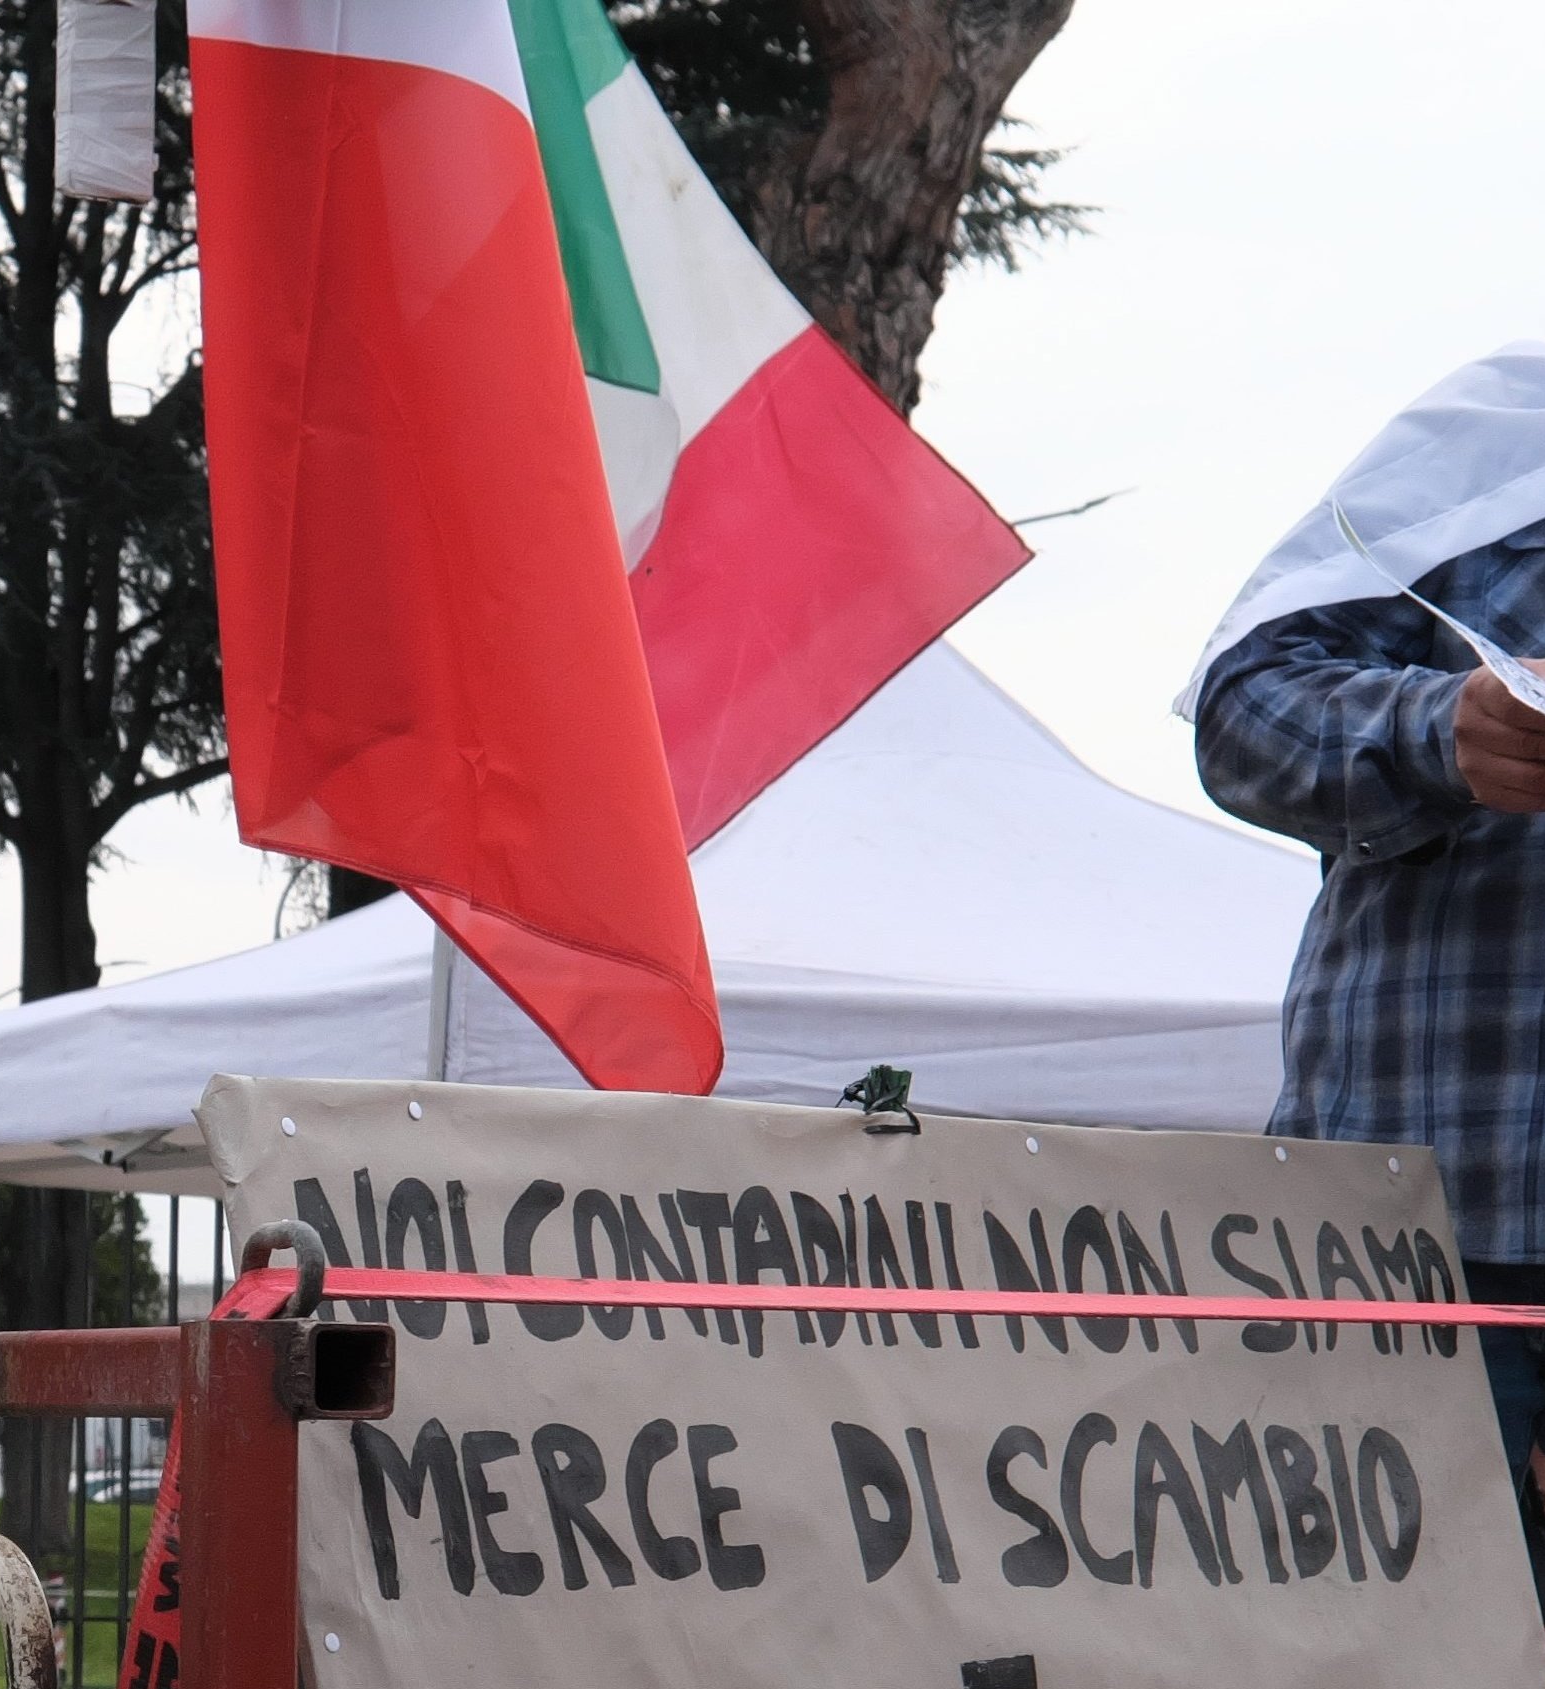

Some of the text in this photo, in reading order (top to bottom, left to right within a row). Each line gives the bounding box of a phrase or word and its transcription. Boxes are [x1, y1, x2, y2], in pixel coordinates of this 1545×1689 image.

[294, 1168, 1462, 1361] NOI CONTADINI NON SIAMO
[351, 1416, 767, 1600] MERCE
[832, 1422, 960, 1583] DI
[987, 1413, 1421, 1589] SCAMBIO
